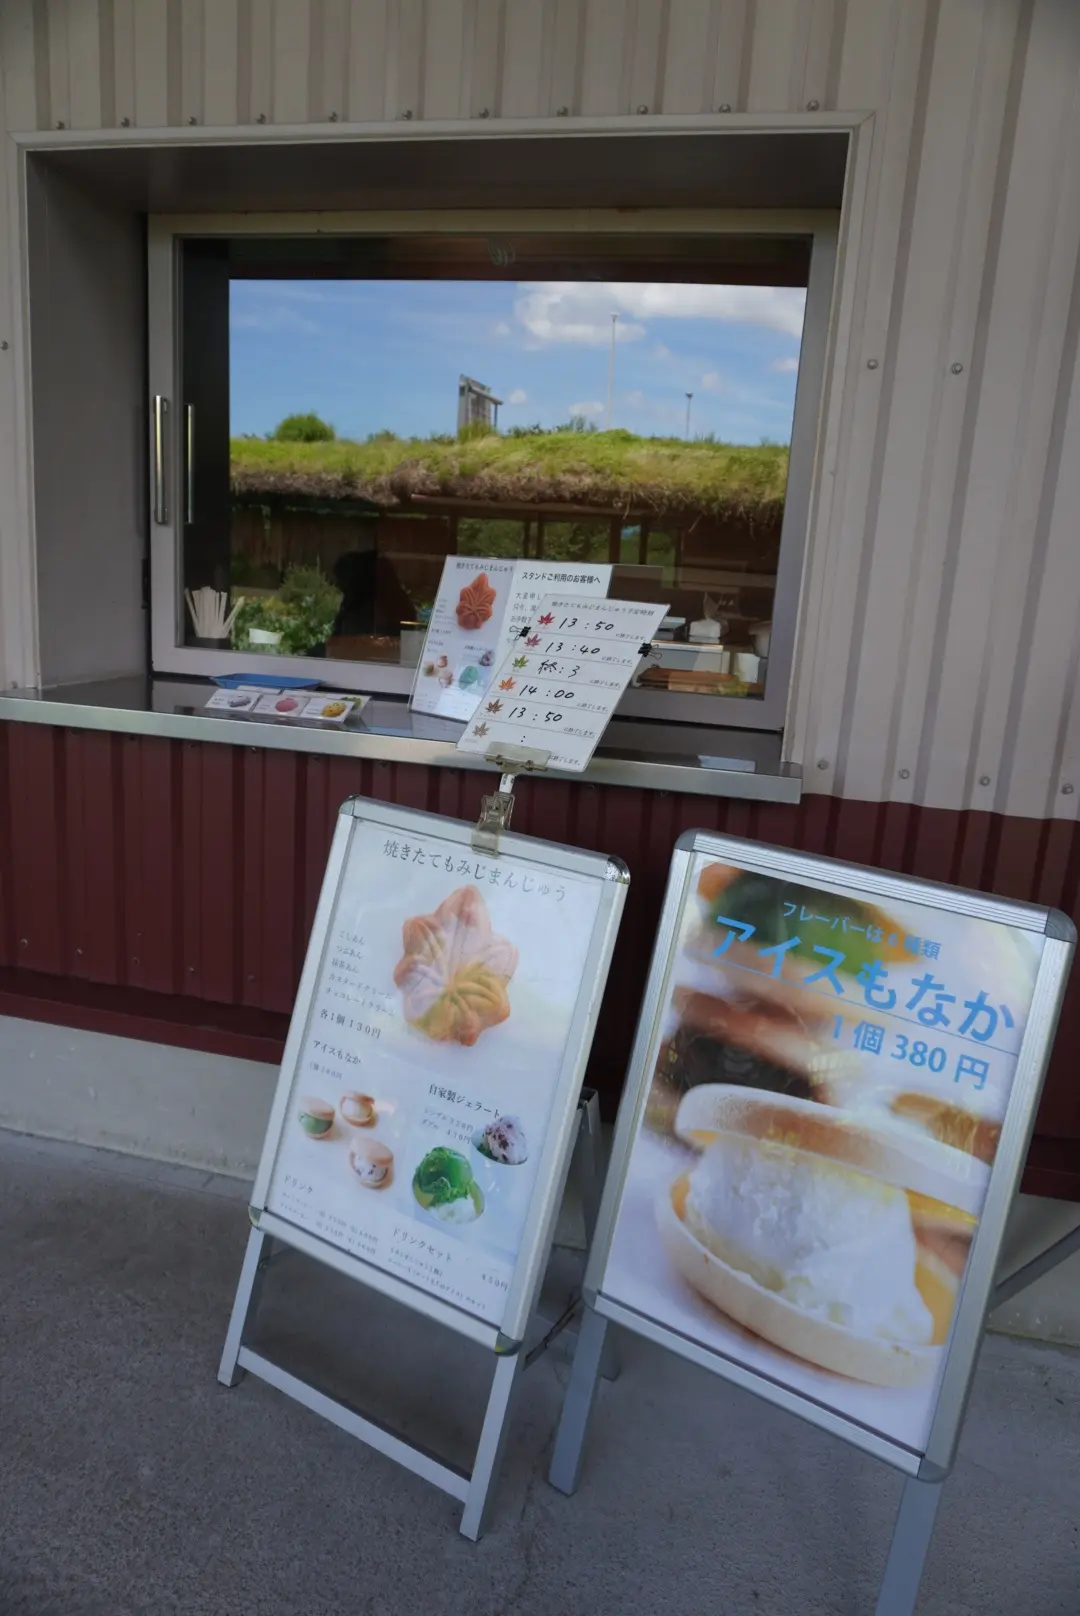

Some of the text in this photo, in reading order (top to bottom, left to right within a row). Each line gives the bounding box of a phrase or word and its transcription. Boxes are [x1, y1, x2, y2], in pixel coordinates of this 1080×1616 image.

[521, 571, 602, 584] スタンドご利用のお客様へ
[558, 617, 615, 632] 13:50
[545, 641, 602, 656] 13:40
[519, 685, 574, 699] 14:00
[509, 707, 562, 722] 13:50
[383, 840, 566, 902] 焼きたてもみじまんじゅう
[783, 902, 942, 960] フレーバーは6種類
[713, 916, 1014, 1041] アイスもなか
[312, 1039, 362, 1065] アイスもなか
[428, 1083, 501, 1120] 自家製ジェラート
[283, 1174, 314, 1195] ドリンク
[392, 1226, 453, 1263] ドリンクセット
